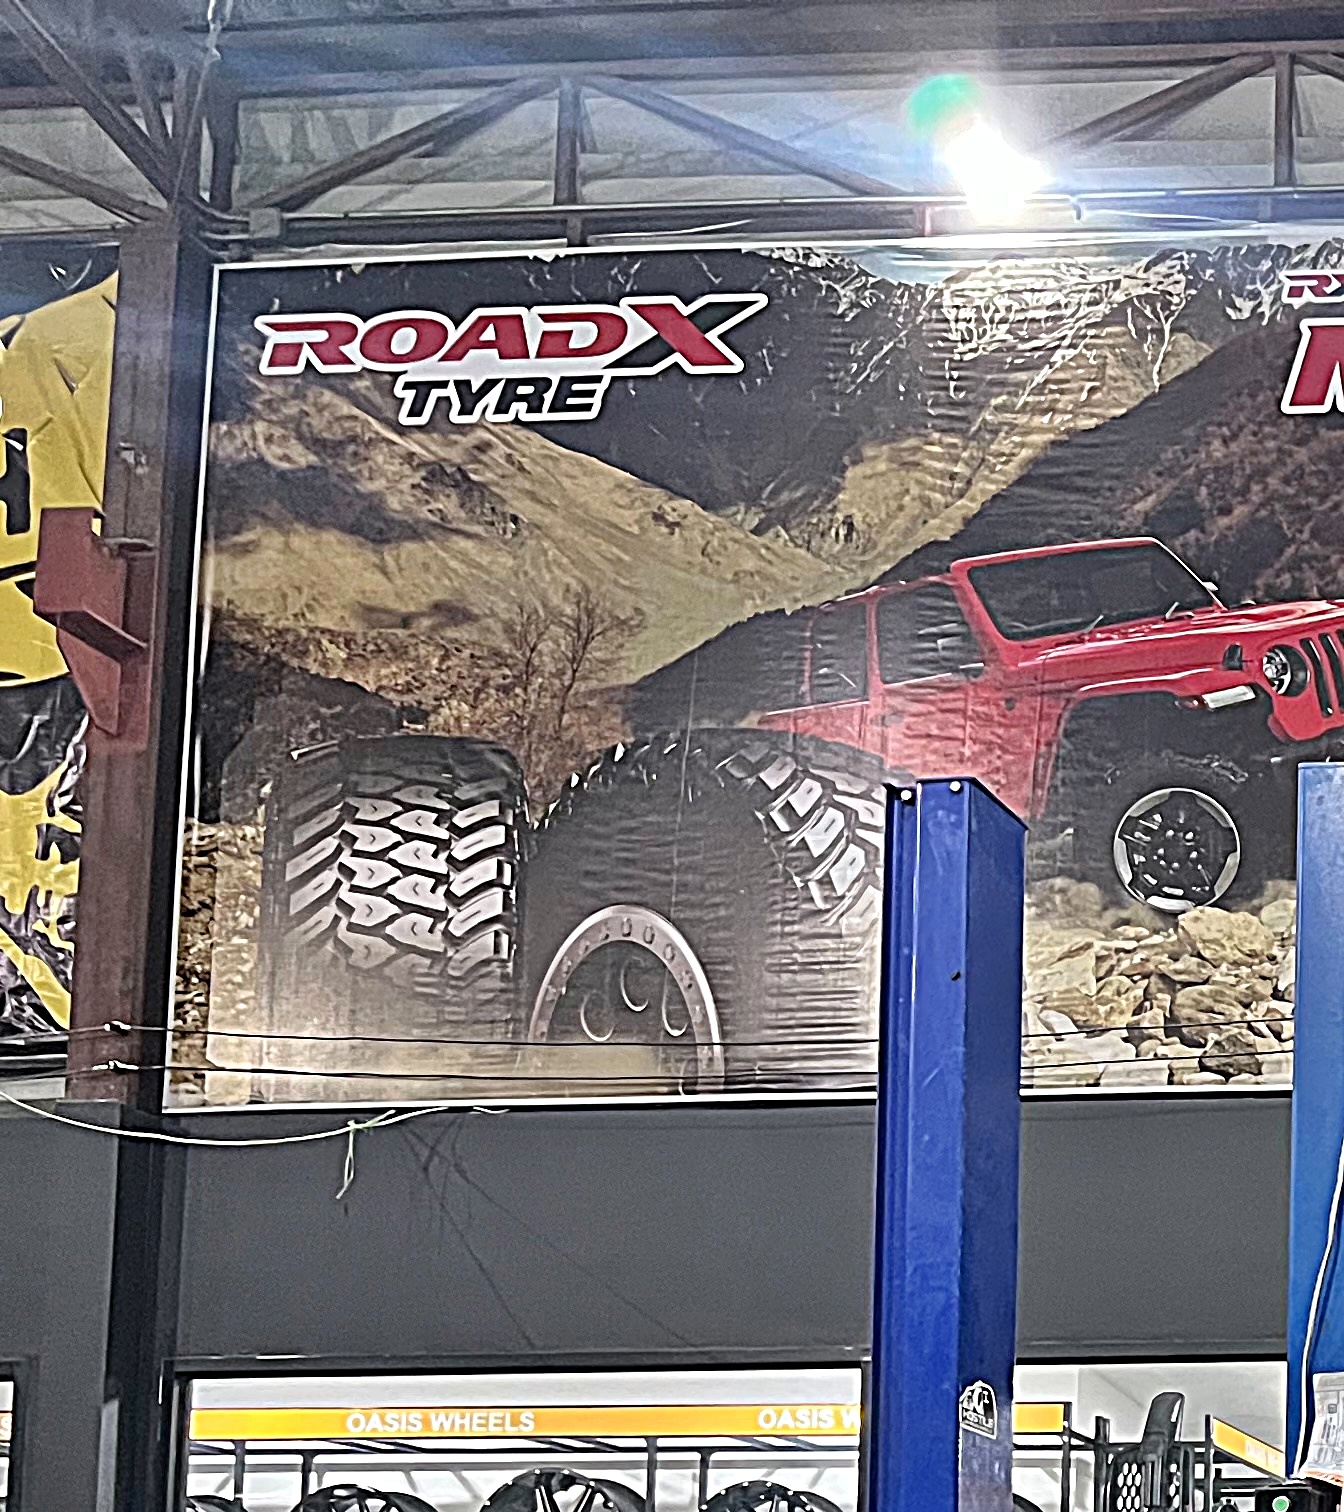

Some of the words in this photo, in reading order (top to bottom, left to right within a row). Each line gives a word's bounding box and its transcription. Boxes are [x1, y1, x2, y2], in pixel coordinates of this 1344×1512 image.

[260, 297, 765, 373] ROADX
[401, 376, 608, 423] TYRE
[346, 1412, 423, 1433] OASIS
[429, 1411, 536, 1433] WHEELS
[757, 1410, 834, 1430] OASIS
